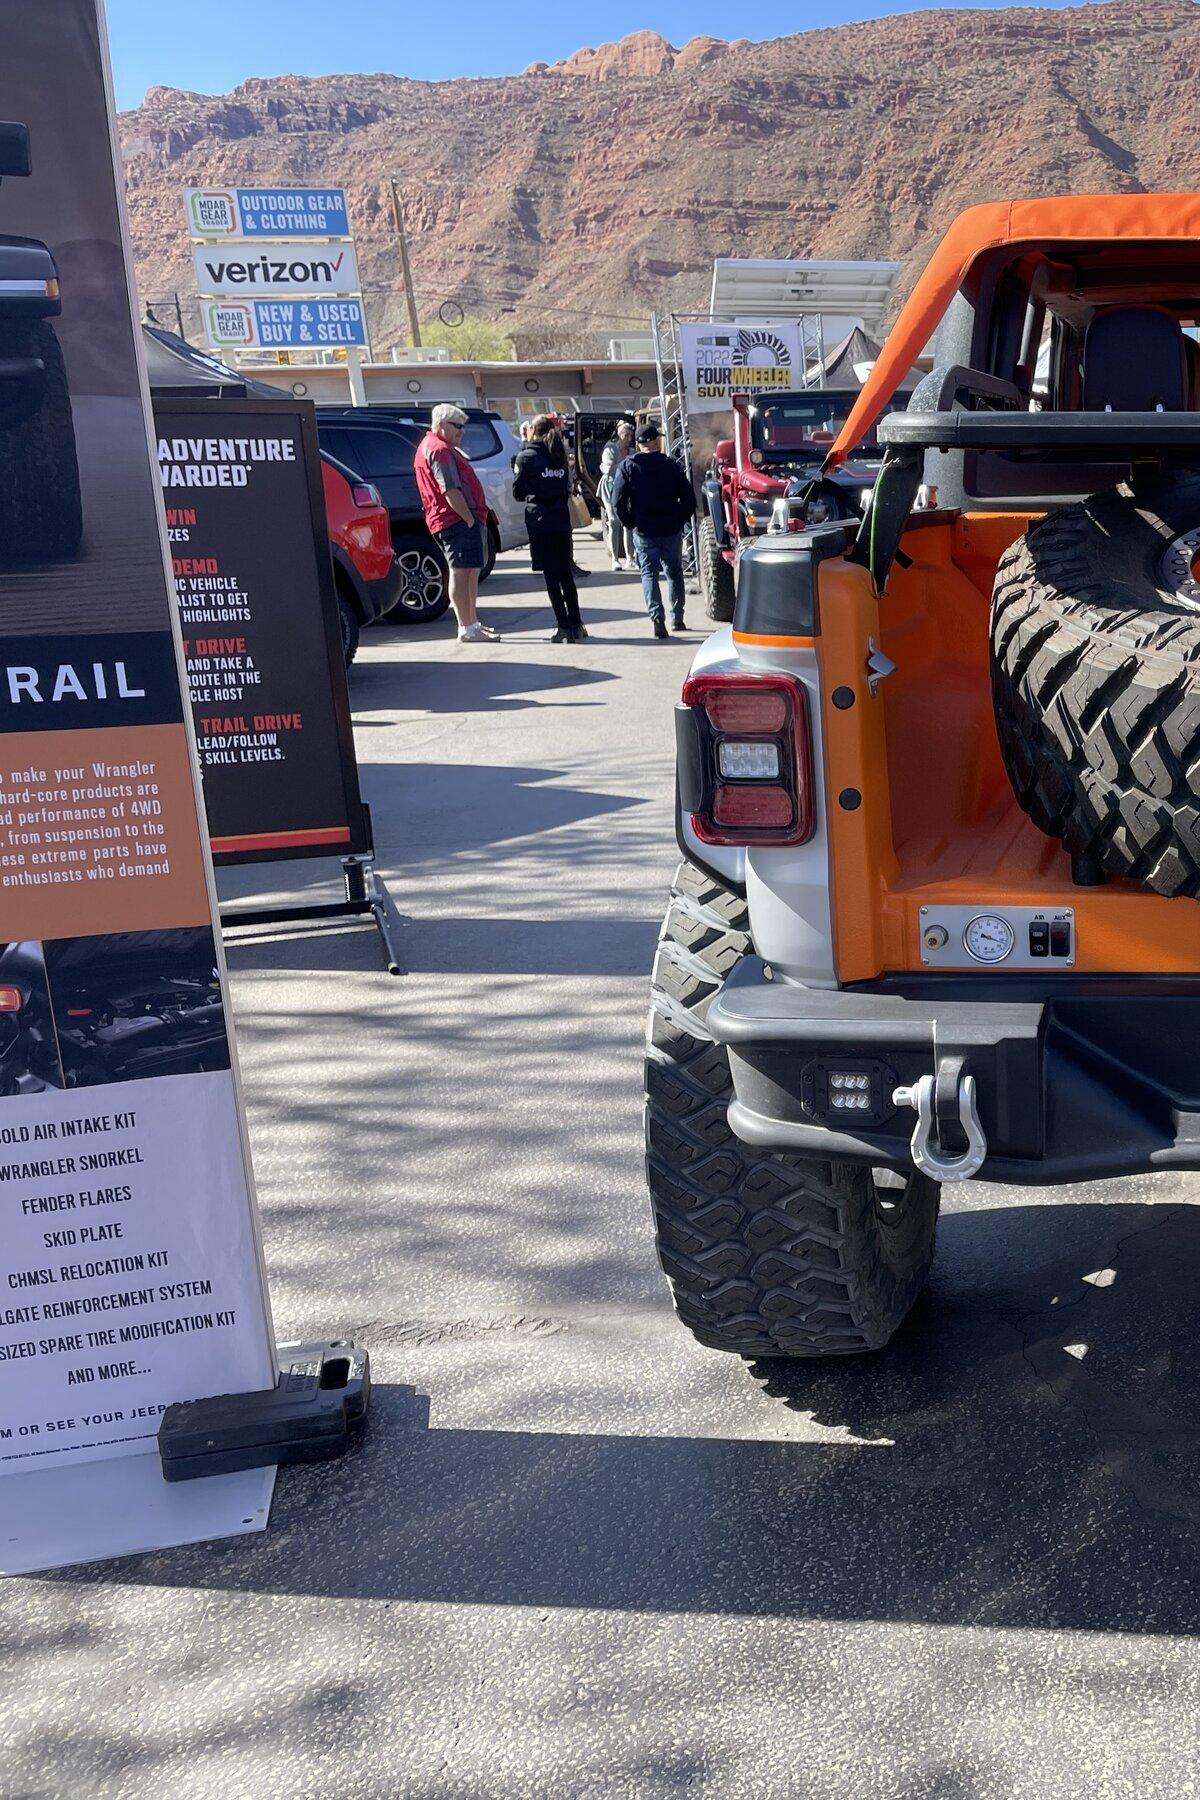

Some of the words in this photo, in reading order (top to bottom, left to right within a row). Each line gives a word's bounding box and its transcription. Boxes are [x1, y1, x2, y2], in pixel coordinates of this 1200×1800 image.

[199, 200, 226, 210] MOAB
[241, 195, 304, 212] OUTDOOR
[308, 195, 344, 212] GEAR
[201, 210, 227, 220] GEAR
[246, 214, 257, 230] &
[260, 213, 327, 230] CLOTHING
[205, 255, 333, 284] verizon
[216, 312, 243, 322] MOAB
[258, 305, 293, 322] NEW
[301, 304, 314, 322] &
[318, 304, 360, 322] USED
[218, 321, 245, 332] GEAR
[261, 324, 293, 342] BUY
[301, 323, 313, 342] &
[317, 323, 356, 341] SELL
[696, 350, 730, 366] 2022
[697, 386, 726, 397] SUV
[158, 438, 296, 461] ADVENTURE
[541, 467, 565, 478] Jeep
[189, 577, 239, 591] VEHICLE
[209, 593, 225, 606] TO
[227, 592, 249, 605] GET
[183, 608, 252, 623] HIGHLIGHTS
[196, 637, 247, 655] DRIVE
[187, 658, 211, 671] AND
[213, 656, 243, 670] TAKE
[246, 656, 254, 669] A
[6, 661, 146, 703] RAIL
[223, 672, 236, 685] IN
[239, 671, 262, 685] THE
[190, 689, 211, 703] CLE
[214, 687, 243, 701] HOST
[200, 716, 250, 734] TRAIL
[253, 713, 303, 731] DRIVE
[197, 733, 277, 750] LEAD/FOLLOW
[205, 750, 238, 765] SKILL
[240, 747, 286, 763] LEVELS.
[11, 767, 47, 783] make
[55, 768, 84, 784] your
[92, 760, 156, 780] Wrangler
[72, 783, 133, 807] products
[137, 783, 159, 796] are
[18, 805, 106, 827] performance
[112, 803, 125, 818] of
[131, 800, 162, 816] 4WD
[8, 830, 41, 845] from
[45, 825, 121, 847] suspension
[125, 825, 139, 838] to
[143, 821, 164, 836] the
[32, 848, 87, 864] extreme
[93, 845, 130, 862] parts
[136, 841, 167, 857] have
[3, 867, 82, 888] enthusiasts
[87, 864, 114, 880] who
[119, 860, 170, 878] demand
[0, 1126, 29, 1144] OLD
[34, 1123, 58, 1141] AIR
[61, 1115, 111, 1137] INTAKE
[114, 1111, 137, 1130] KIT
[0, 1157, 76, 1182] WRANGLER
[79, 1147, 144, 1171] SNORKEL
[21, 1193, 76, 1215] FENDER
[79, 1185, 132, 1208] FLARES
[43, 1229, 77, 1248] SKID
[80, 1222, 123, 1244] PLATE
[8, 1268, 58, 1289] CHMSL
[60, 1254, 145, 1282] RELOCATION
[147, 1250, 170, 1269] KIT
[43, 1288, 156, 1320] REINFORCEMENT
[158, 1279, 212, 1301] SYSTEM
[39, 1334, 84, 1355] SPARE
[85, 1329, 117, 1348] TIRE
[119, 1313, 213, 1343] MODIFICATION
[216, 1310, 236, 1327] KIT
[67, 1367, 95, 1385] AND
[98, 1360, 152, 1380] MORE...
[18, 1424, 40, 1437] OR
[46, 1418, 76, 1432] SEE
[81, 1411, 125, 1427] YOUR
[130, 1404, 166, 1419] JEEP
